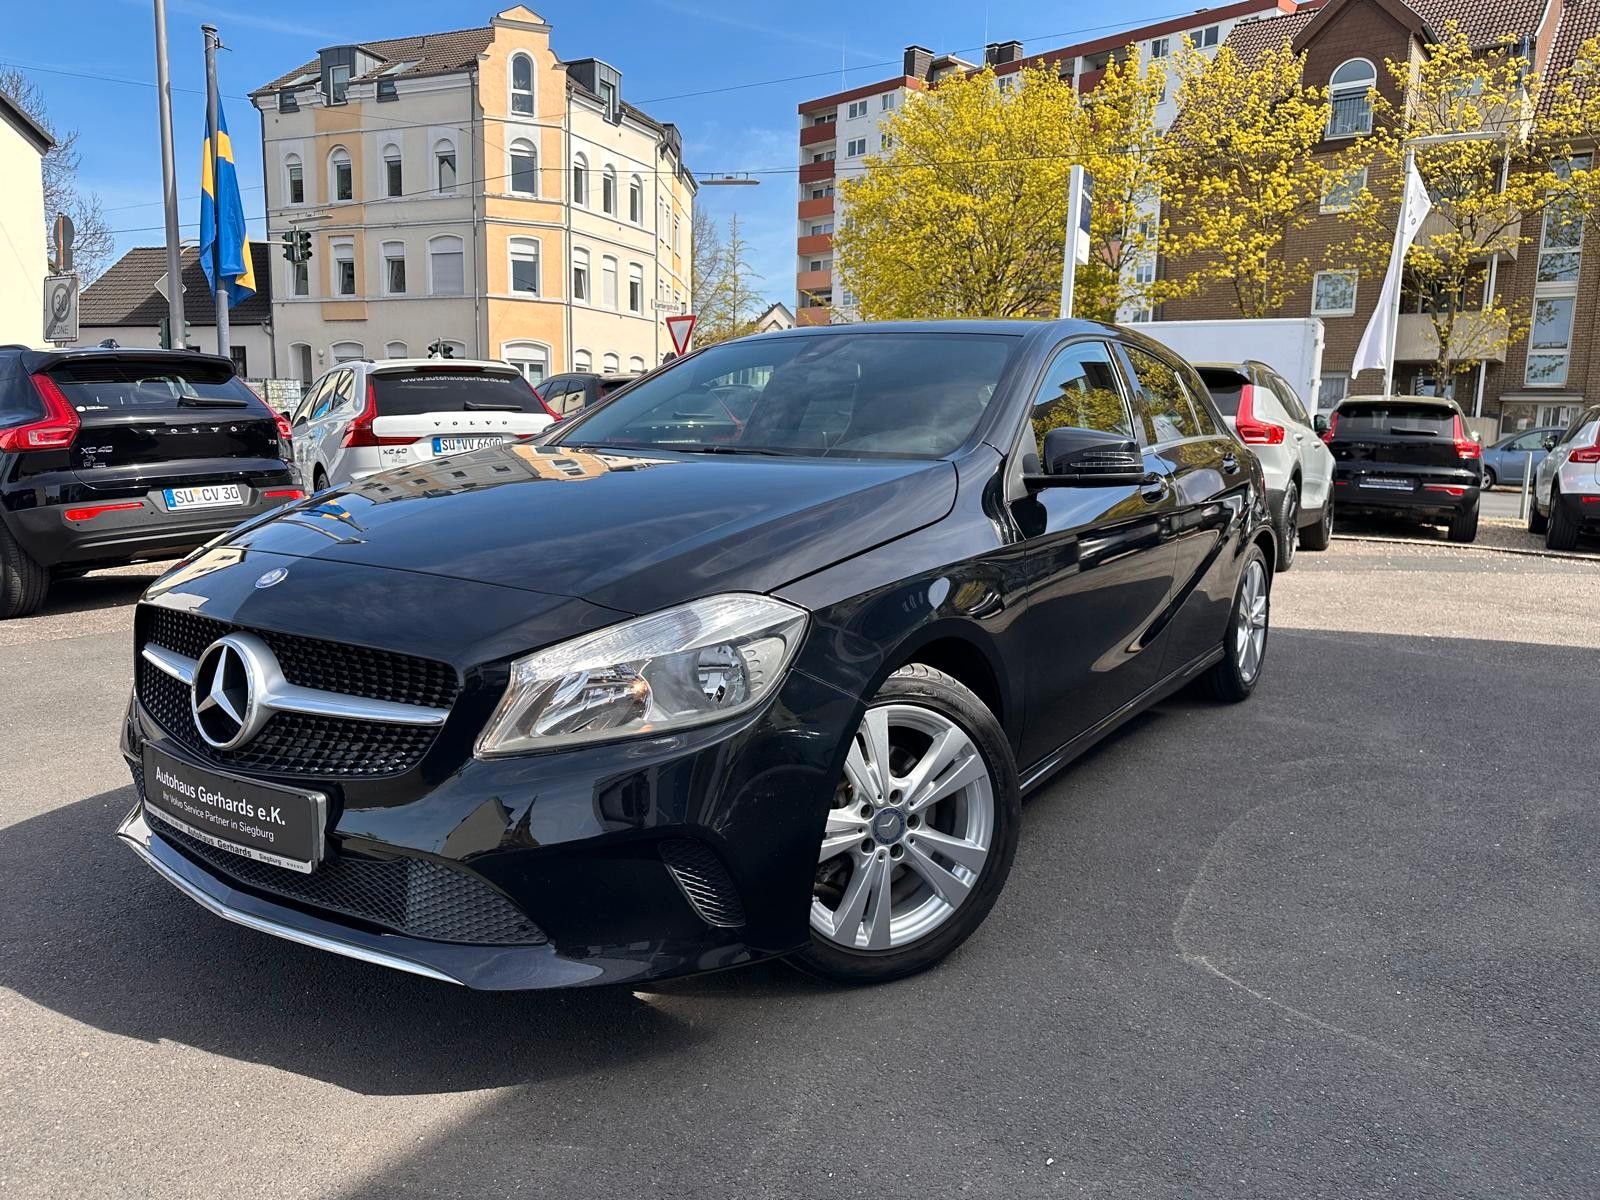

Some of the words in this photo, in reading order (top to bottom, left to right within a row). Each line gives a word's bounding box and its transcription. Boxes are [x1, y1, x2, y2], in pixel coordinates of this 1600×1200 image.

[146, 425, 238, 435] VOLVO
[441, 440, 456, 452] SU
[460, 439, 475, 451] VV
[174, 488, 195, 504] SU
[201, 487, 220, 502] CV
[222, 486, 240, 500] 30
[156, 766, 196, 799] Autohaus
[197, 786, 254, 818] Gerhards
[257, 806, 286, 826] e.K.
[162, 790, 170, 801] Ihr
[170, 794, 184, 809] Volvo
[183, 801, 205, 819] Service
[205, 810, 230, 828] Partner
[230, 819, 238, 830] in
[239, 821, 275, 842] Siegburg
[187, 826, 215, 846] Autohaus
[216, 839, 252, 858] Gerhards
[258, 852, 282, 866] Siegburg
